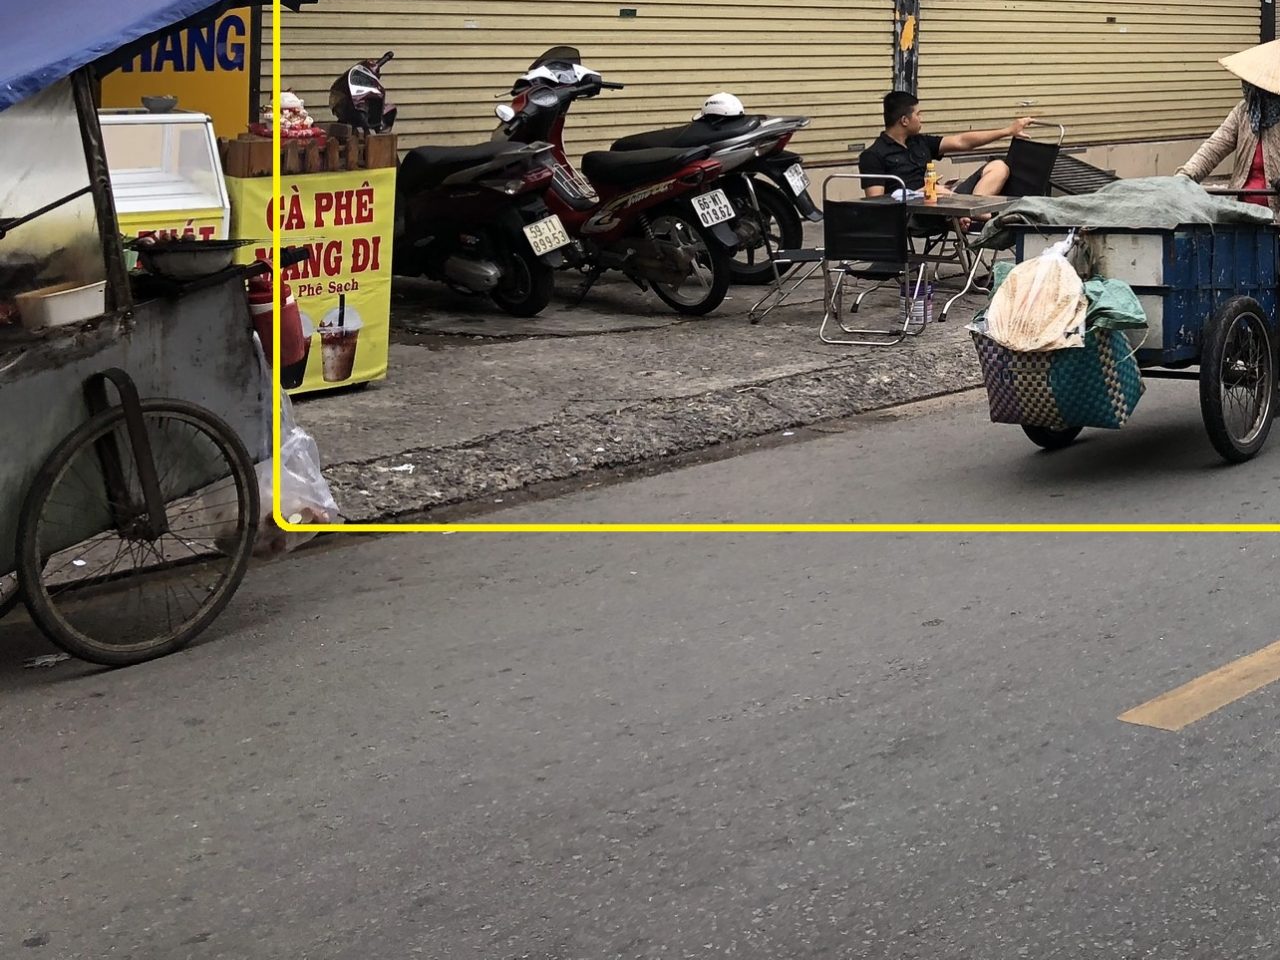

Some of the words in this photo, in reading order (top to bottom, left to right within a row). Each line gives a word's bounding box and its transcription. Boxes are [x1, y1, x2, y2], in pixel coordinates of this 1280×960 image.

[265, 185, 306, 233] CÀ
[313, 181, 375, 229] PHÊ
[350, 236, 382, 274] ĐI
[297, 283, 323, 298] Phê
